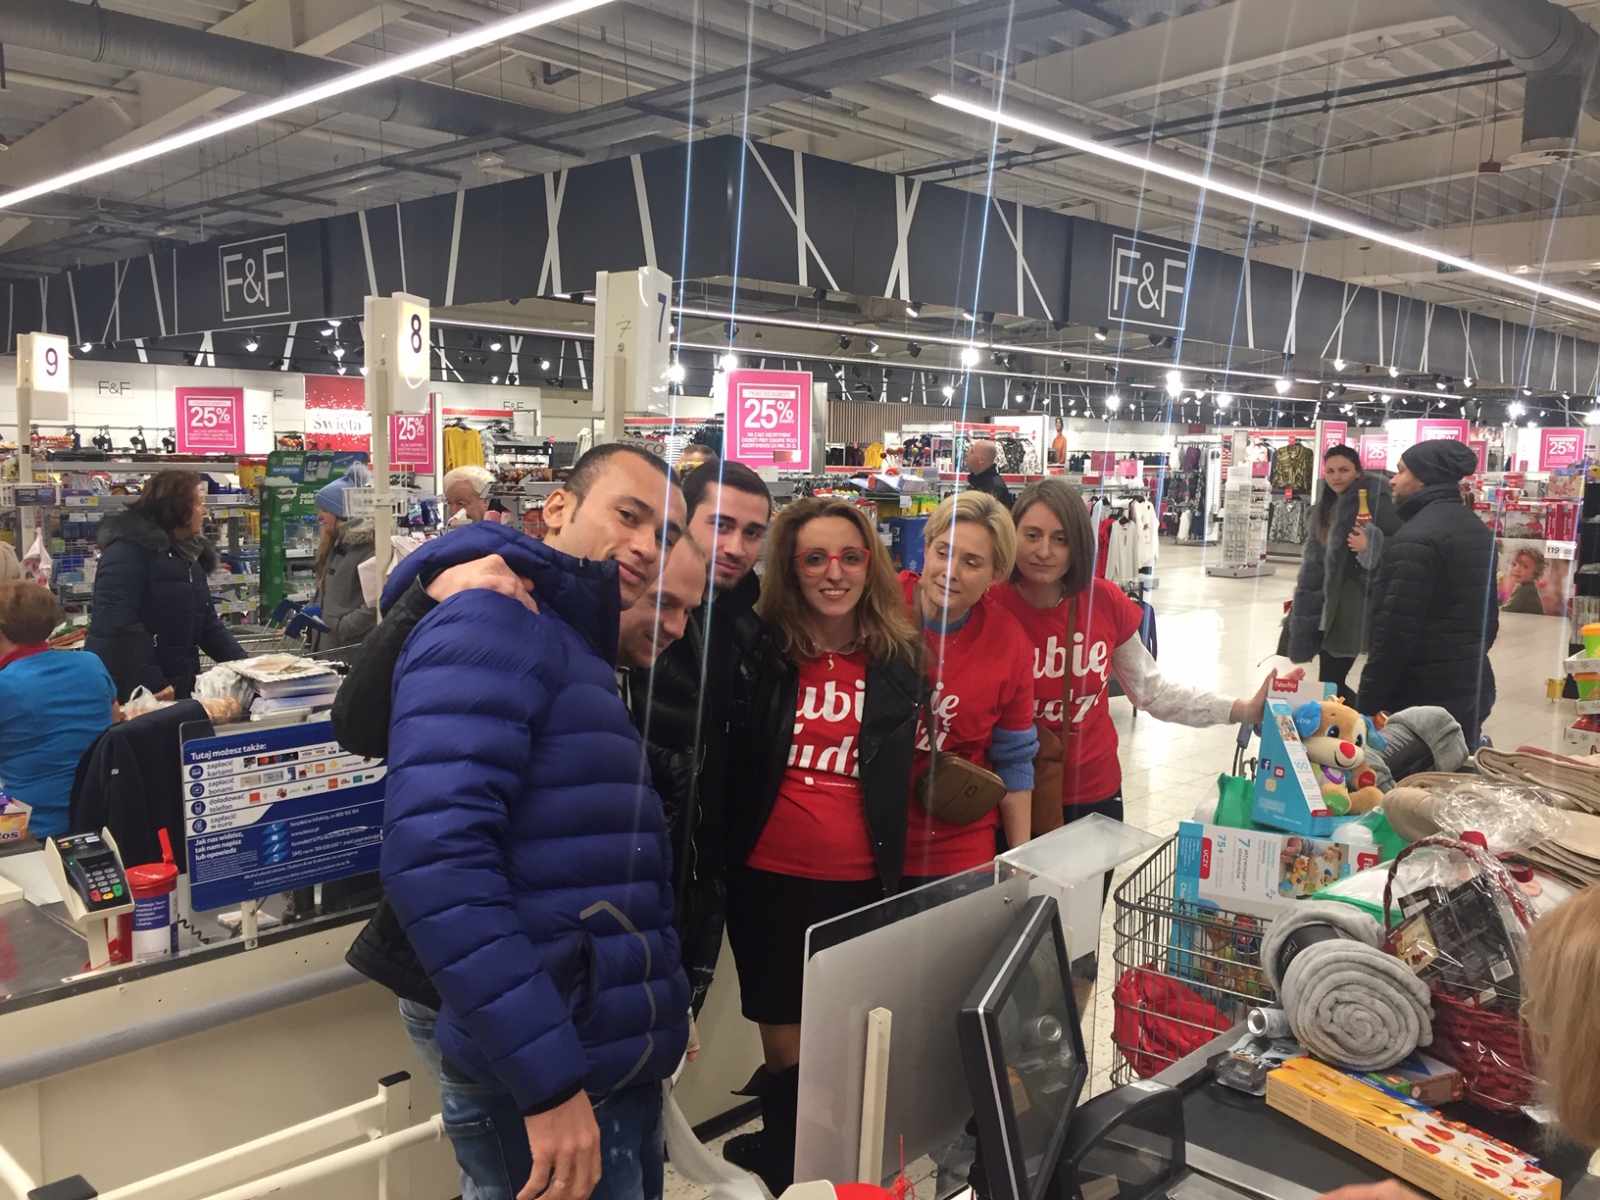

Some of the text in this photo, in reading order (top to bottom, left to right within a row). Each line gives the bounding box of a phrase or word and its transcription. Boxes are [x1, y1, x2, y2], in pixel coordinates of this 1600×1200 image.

[223, 246, 284, 312] F&F
[1114, 248, 1186, 318] F&F
[658, 292, 666, 343] 7
[411, 314, 422, 354] 8
[616, 320, 632, 338] 7
[45, 348, 58, 376] 9
[98, 380, 130, 395] F&F
[190, 407, 230, 427] 25%
[744, 399, 794, 429] 25%
[313, 414, 361, 432] Święta
[398, 417, 424, 440] 25%
[1549, 441, 1575, 455] 25%
[796, 680, 865, 722] ubi
[190, 743, 266, 760] Tutaj możesz także:
[207, 760, 233, 769] zapłacić
[208, 768, 233, 777] kartami
[208, 778, 234, 787] zapłacić
[209, 786, 233, 795] bonami
[209, 794, 244, 805] doładować
[210, 804, 233, 813] telefon
[210, 813, 236, 823] zapłacić
[0, 832, 19, 840] os
[219, 832, 244, 841] widzisz,
[1238, 838, 1250, 848] 7
[222, 840, 241, 849] napisz
[1217, 835, 1226, 854] 75+
